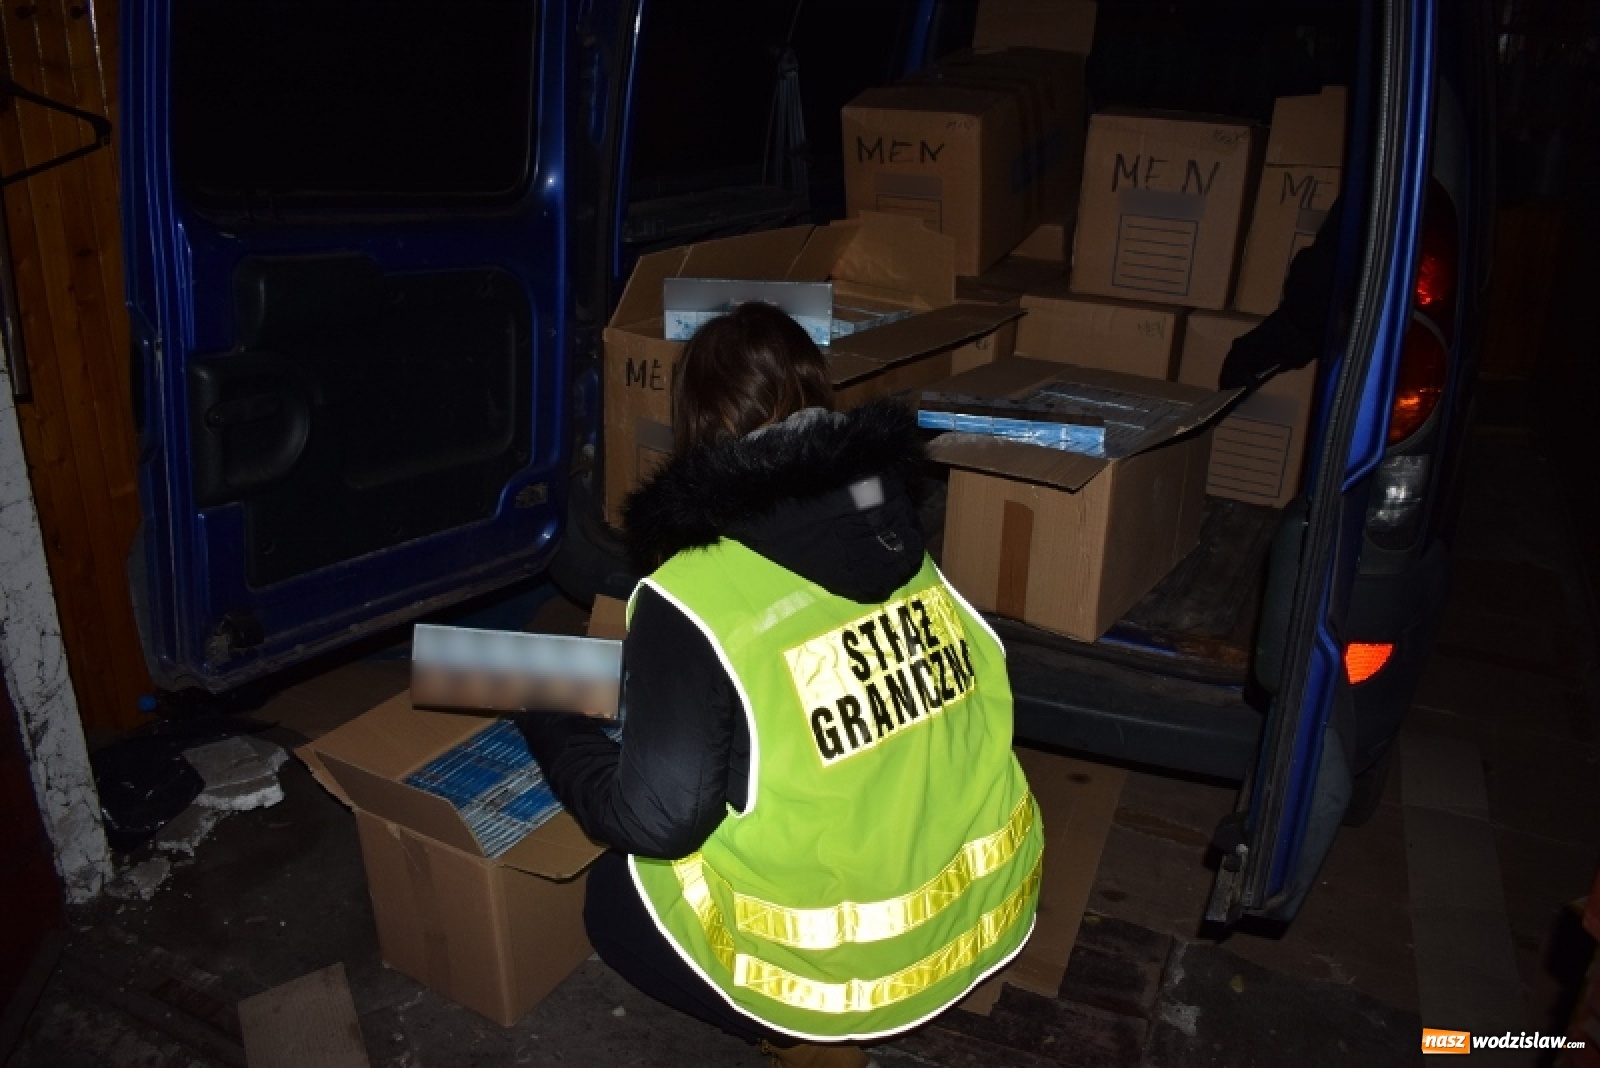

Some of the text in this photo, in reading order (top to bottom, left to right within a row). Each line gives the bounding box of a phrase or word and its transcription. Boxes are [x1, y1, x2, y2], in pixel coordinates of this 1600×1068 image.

[856, 135, 945, 164] MEN
[1111, 153, 1220, 195] MEN
[1280, 171, 1335, 209] ME
